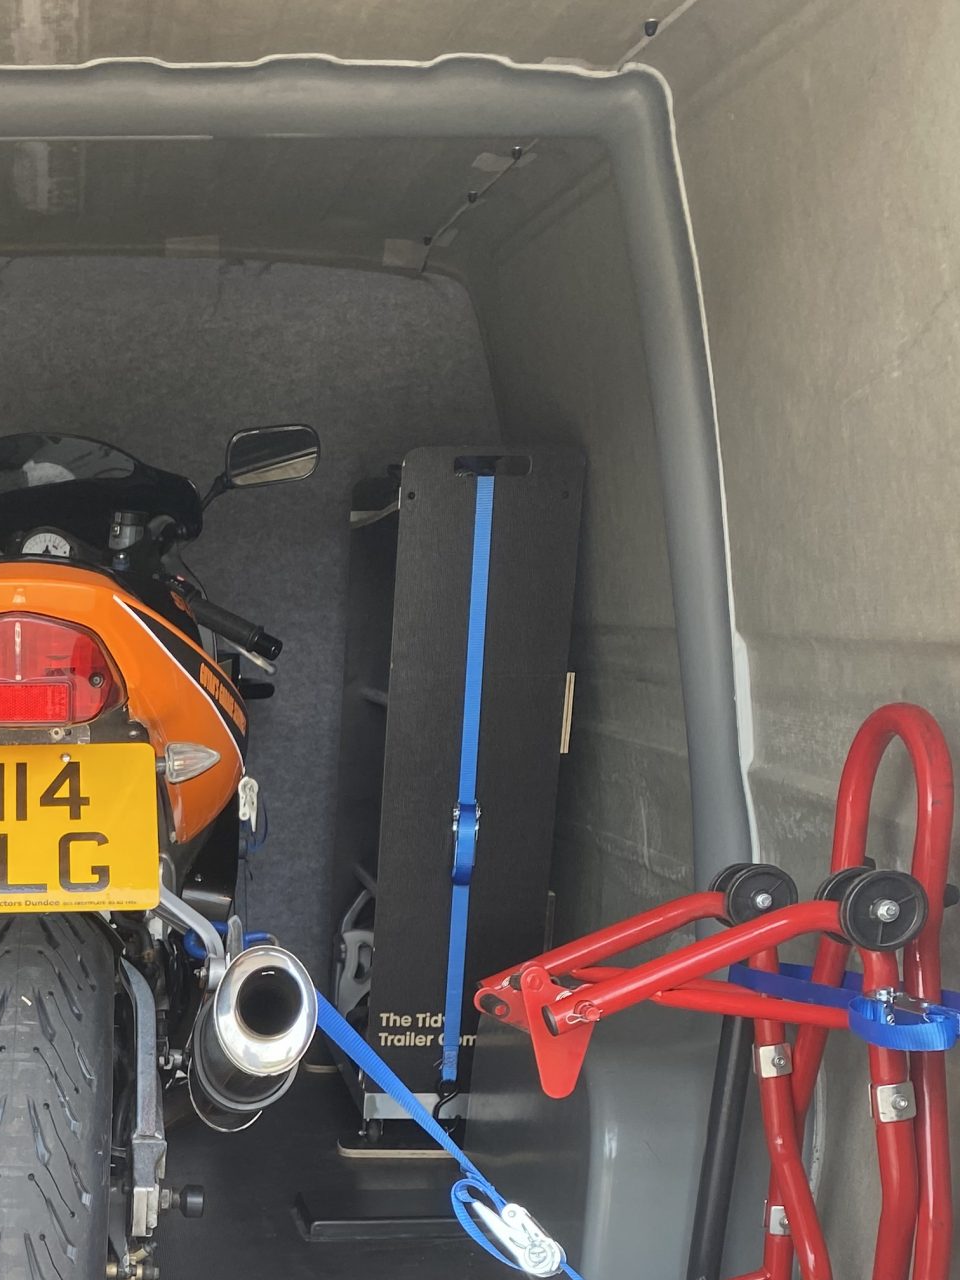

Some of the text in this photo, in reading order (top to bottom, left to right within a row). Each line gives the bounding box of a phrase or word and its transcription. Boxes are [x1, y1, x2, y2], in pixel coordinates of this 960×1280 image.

[380, 1012, 446, 1028] The Tid
[379, 1031, 434, 1047] Trailer
